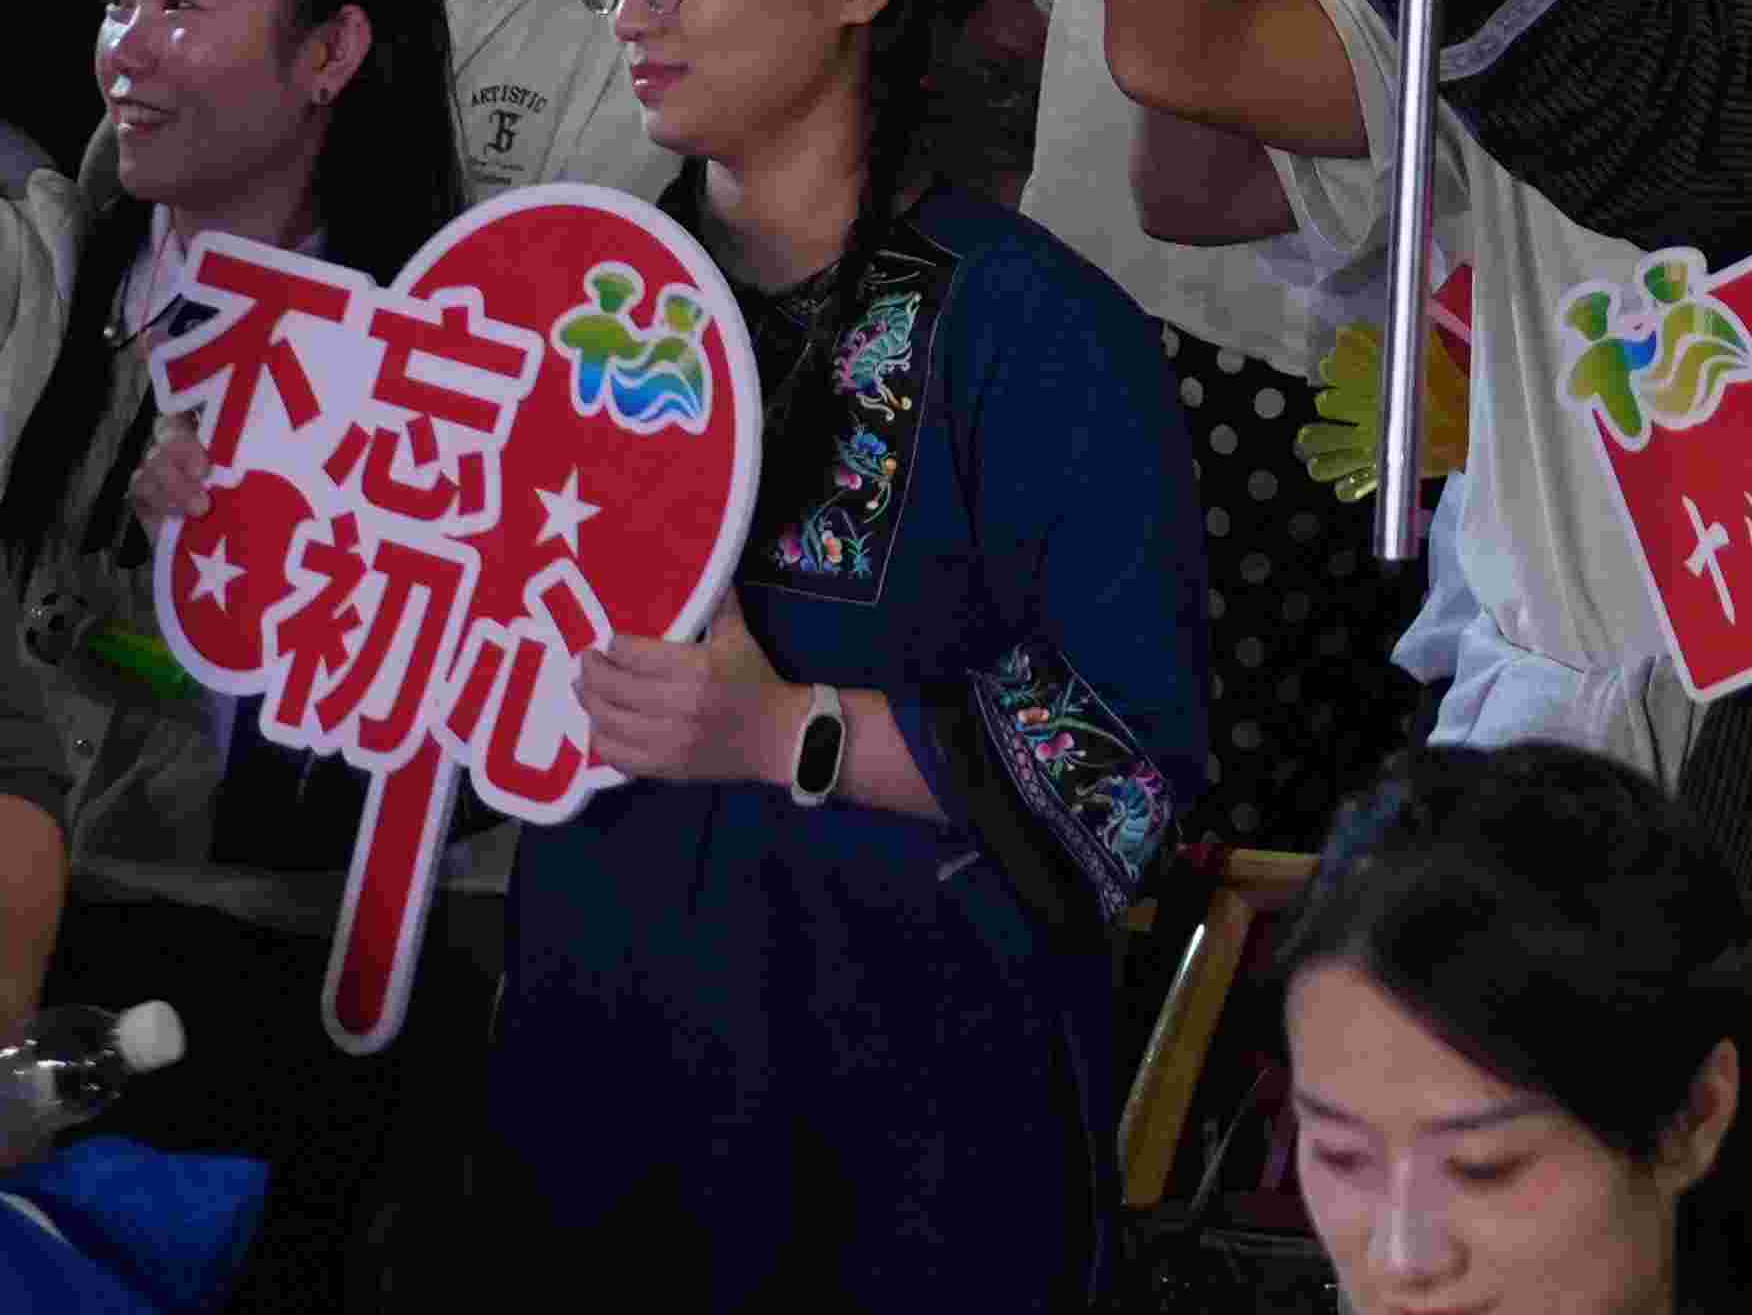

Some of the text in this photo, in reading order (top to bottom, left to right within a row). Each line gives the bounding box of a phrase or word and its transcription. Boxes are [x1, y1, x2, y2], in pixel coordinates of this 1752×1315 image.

[471, 84, 548, 114] ARTISTIC
[165, 247, 530, 519] 不忘
[275, 512, 598, 806] 初心
